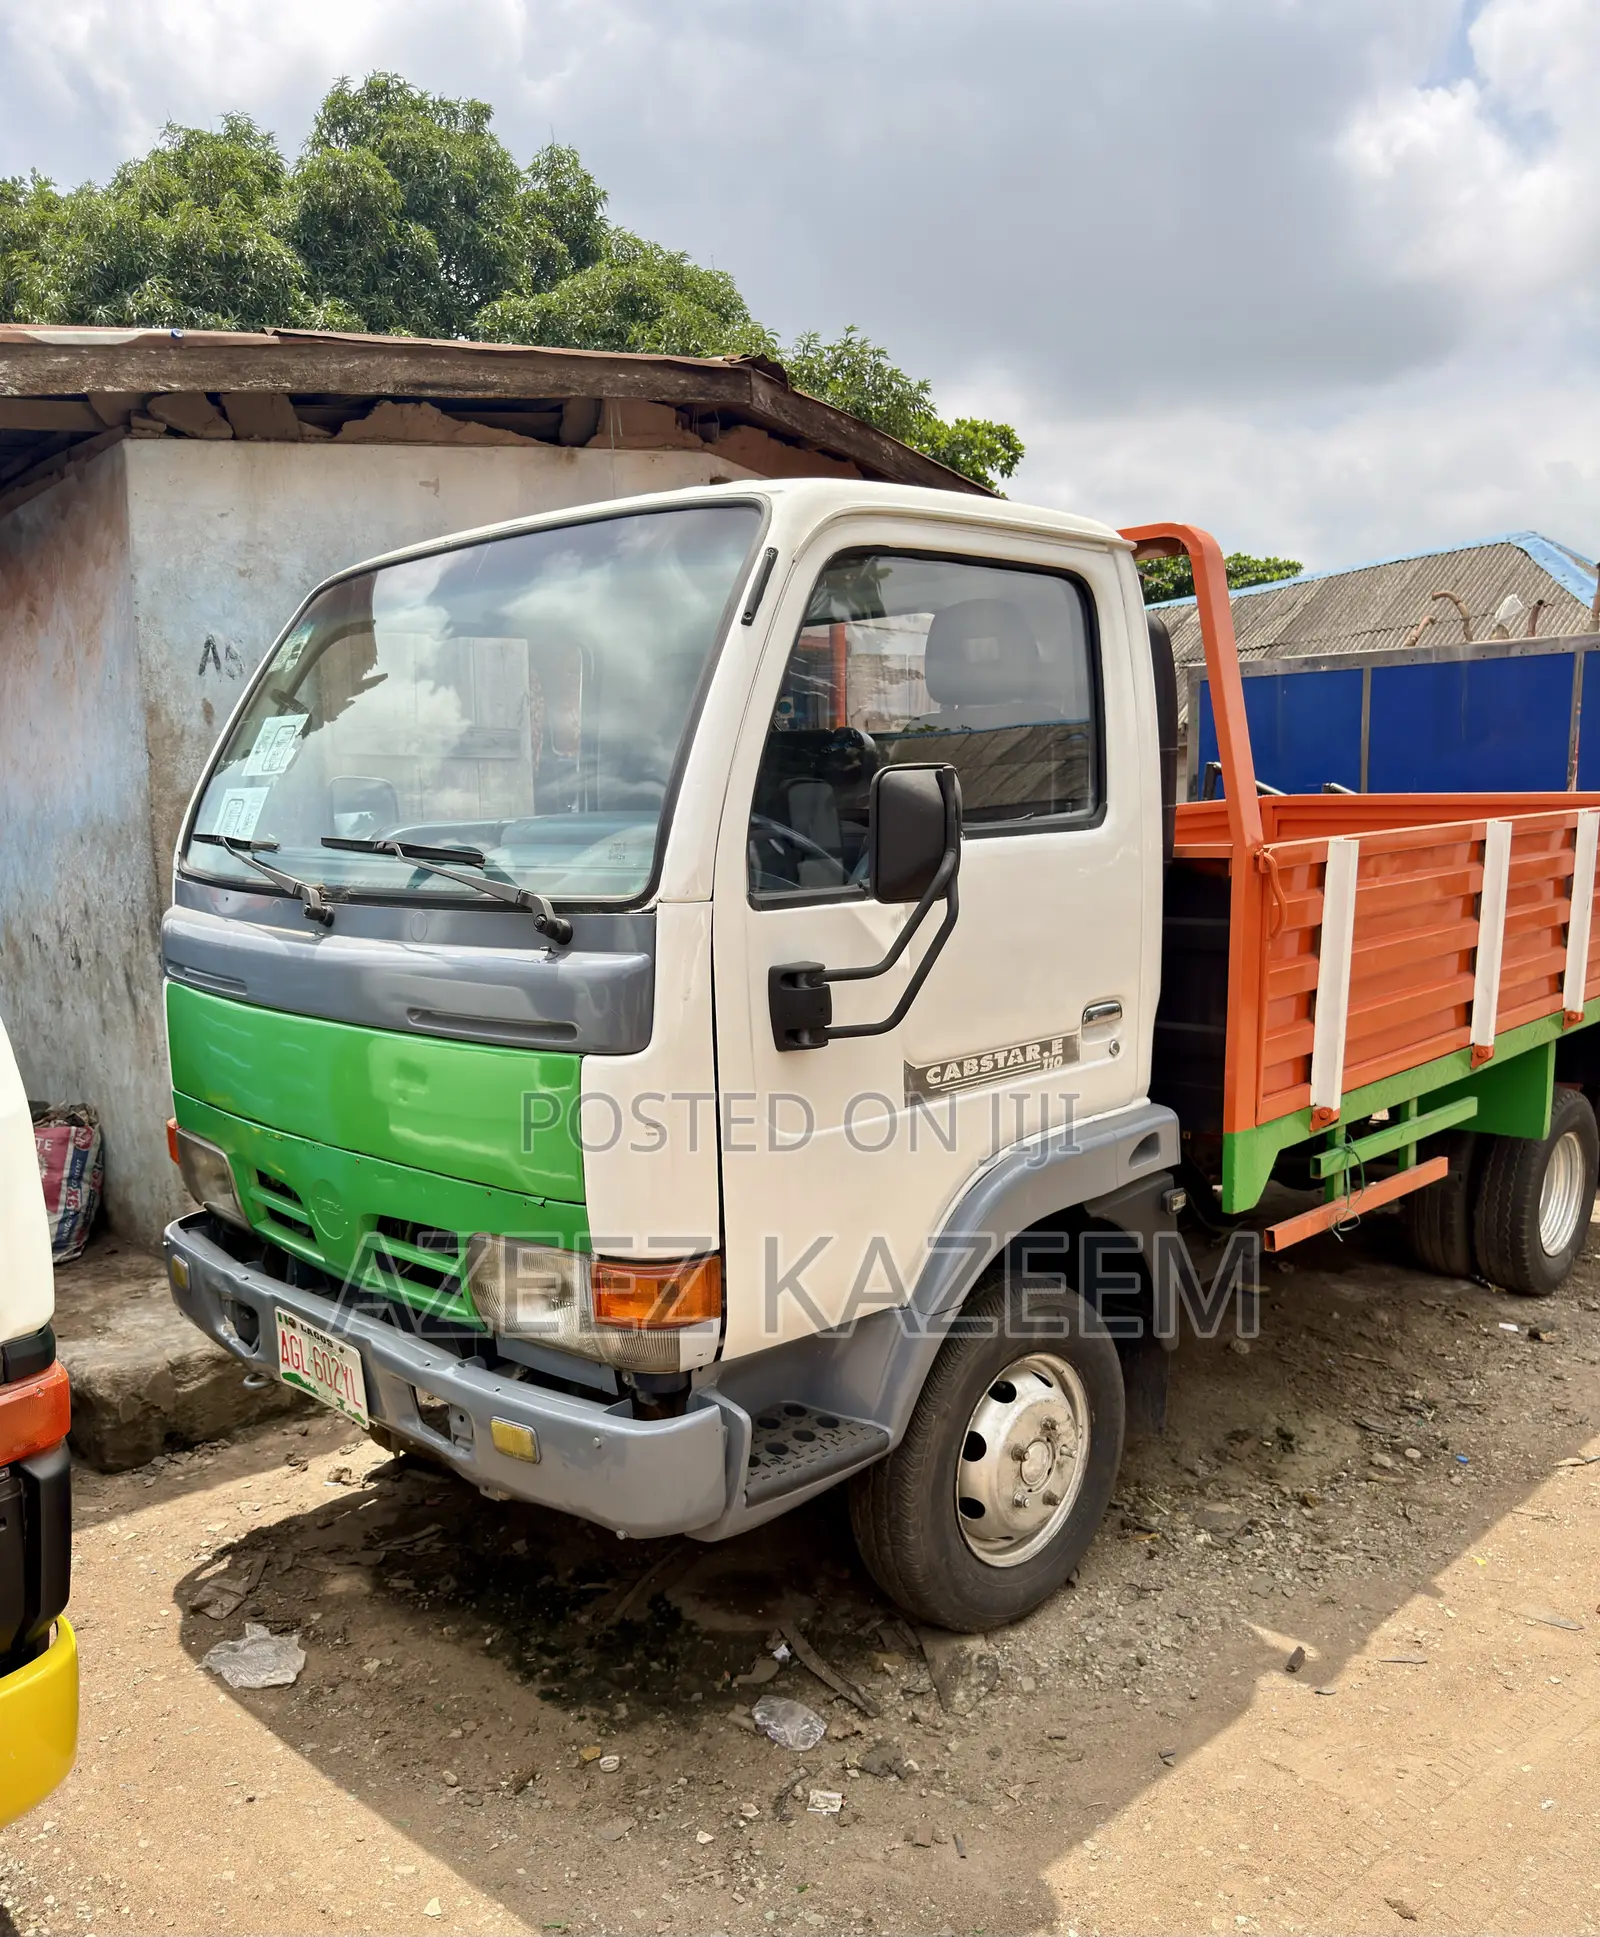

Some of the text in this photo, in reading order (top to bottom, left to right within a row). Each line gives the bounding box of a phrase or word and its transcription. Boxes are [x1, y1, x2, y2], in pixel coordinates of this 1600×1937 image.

[925, 1038, 1064, 1085] CABSTAR.E
[1042, 1055, 1064, 1072] 110
[300, 1323, 333, 1348] LAGOS
